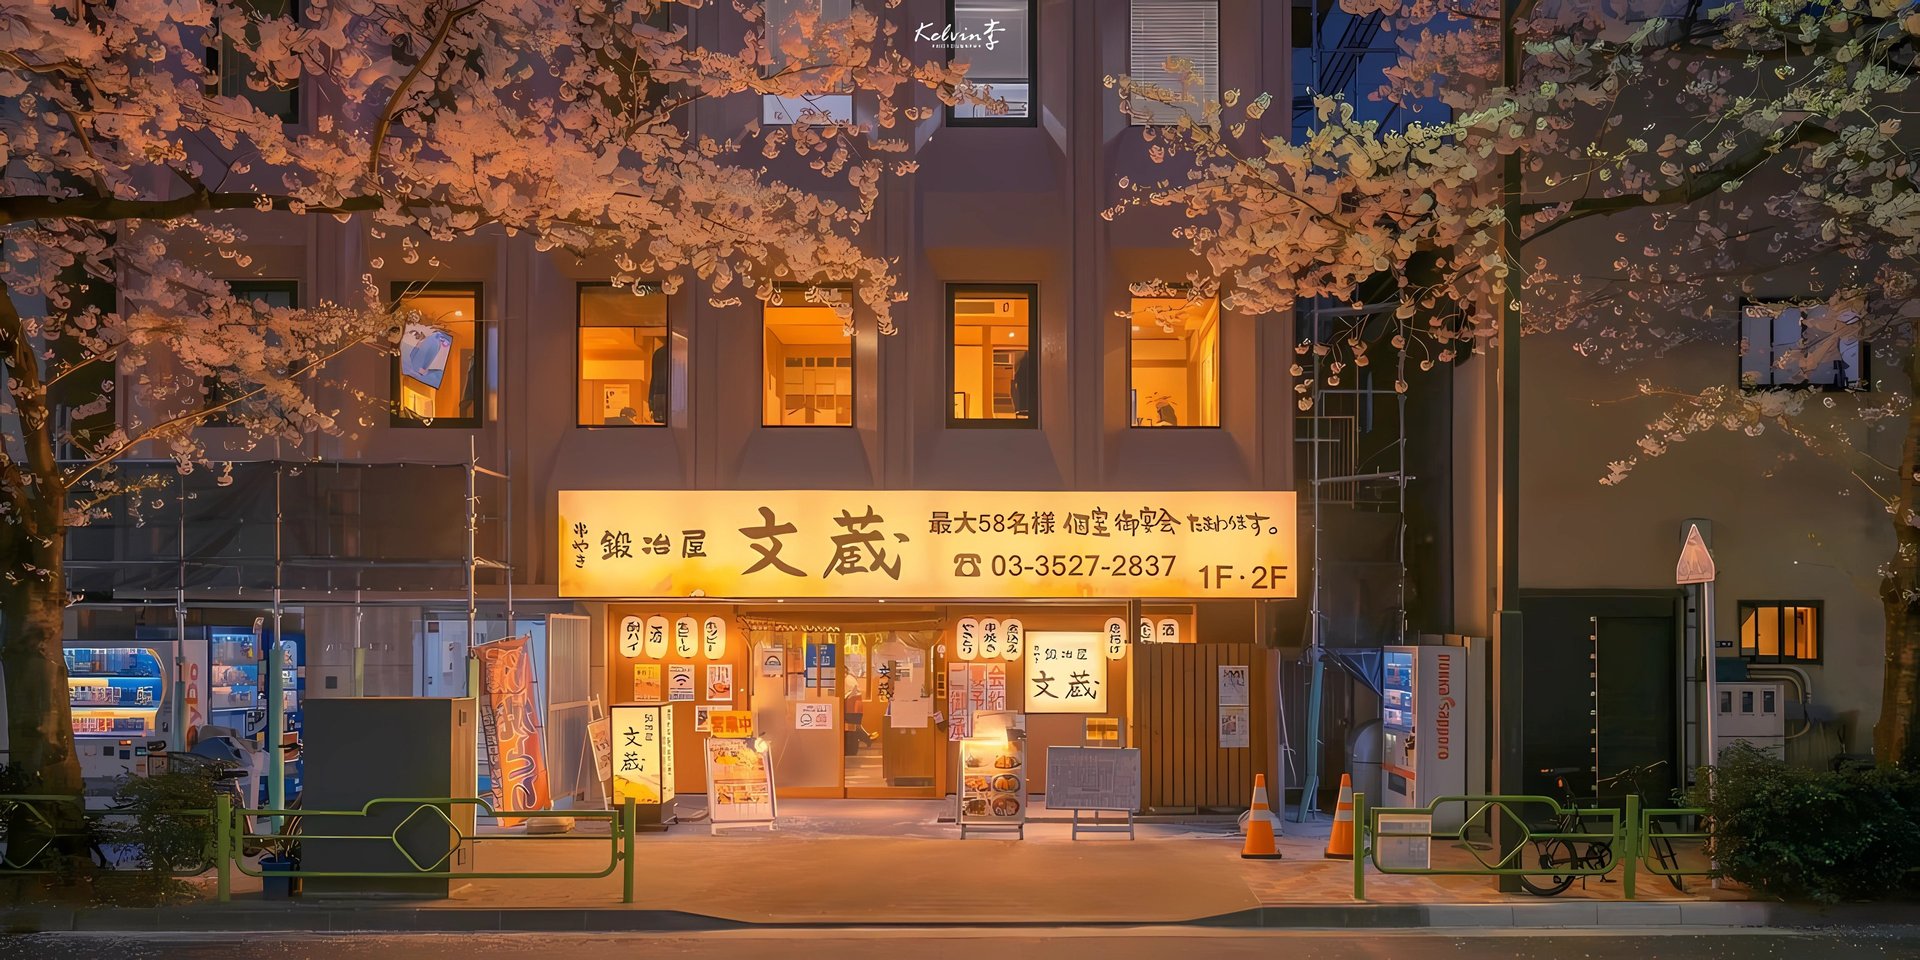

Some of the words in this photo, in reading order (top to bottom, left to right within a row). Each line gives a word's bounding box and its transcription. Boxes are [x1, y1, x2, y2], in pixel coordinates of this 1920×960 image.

[928, 511, 1056, 535] 最大58名様
[1186, 512, 1278, 537] たまわります。
[600, 529, 707, 560] 鍛冶屋
[738, 506, 910, 581] 文蔵
[991, 554, 1177, 577] 03-3527-2837
[1162, 623, 1175, 637] 酒
[1031, 669, 1100, 700] 文蔵
[620, 726, 646, 772] 文蔵
